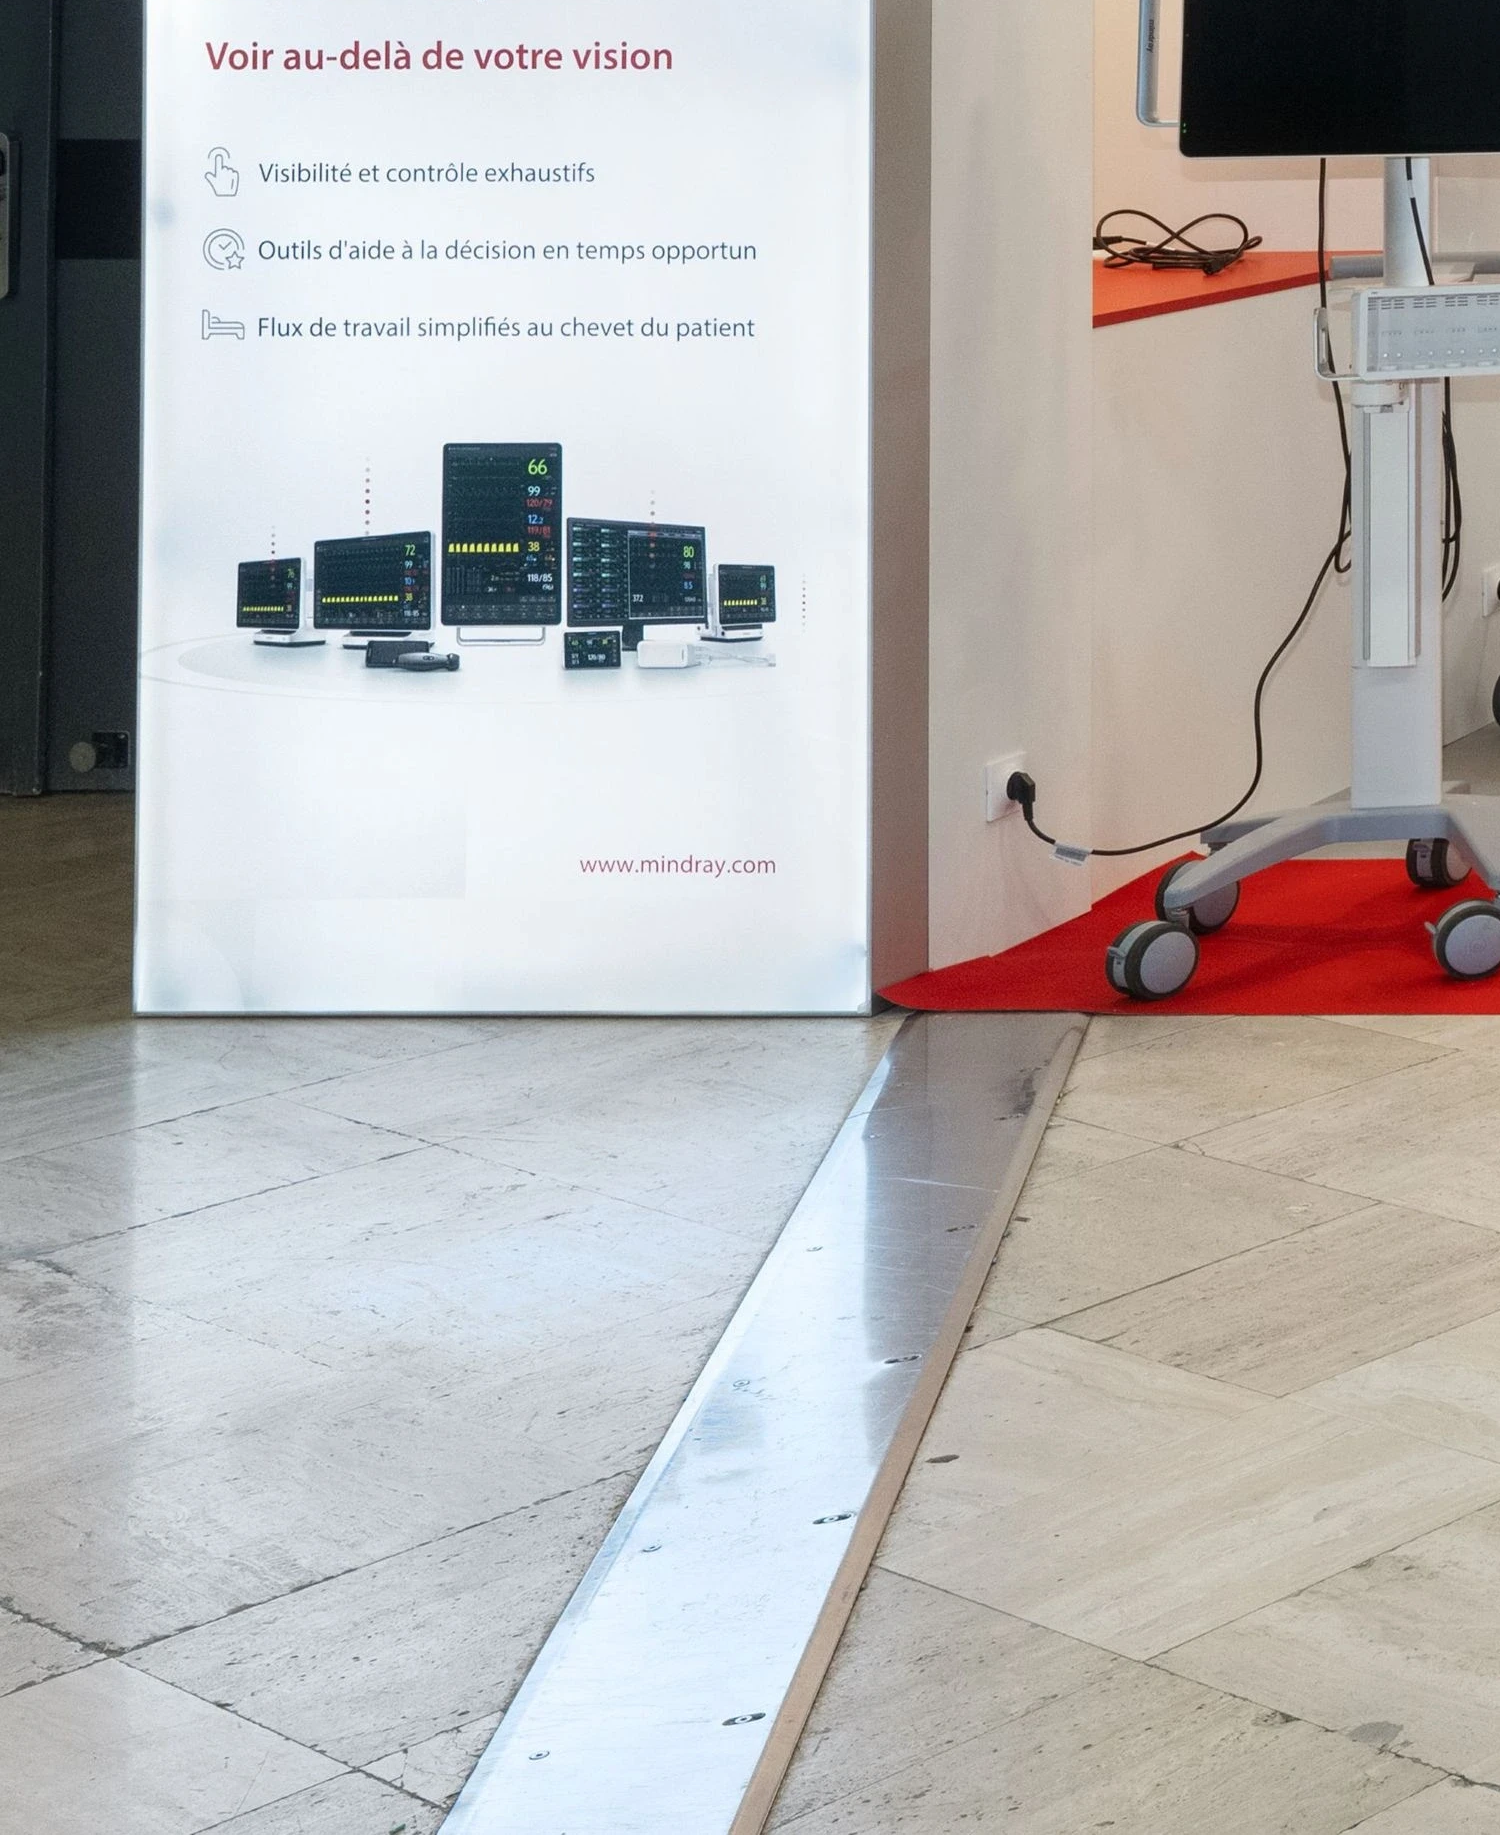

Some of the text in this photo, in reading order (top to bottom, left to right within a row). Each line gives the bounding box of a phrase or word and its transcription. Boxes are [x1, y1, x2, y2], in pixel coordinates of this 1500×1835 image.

[206, 41, 672, 70] Voir au-delà de votre vision
[259, 162, 594, 182] Visibilité et contrôle exhaustifs
[259, 240, 756, 264] Outils d'aide à la décision en temps opportun
[259, 317, 754, 341] Flux de travail simplifiés au chevet du patient
[528, 458, 548, 475] 66
[528, 486, 541, 496] 99
[528, 542, 540, 552] 38
[580, 855, 775, 878] www.mindray.com
